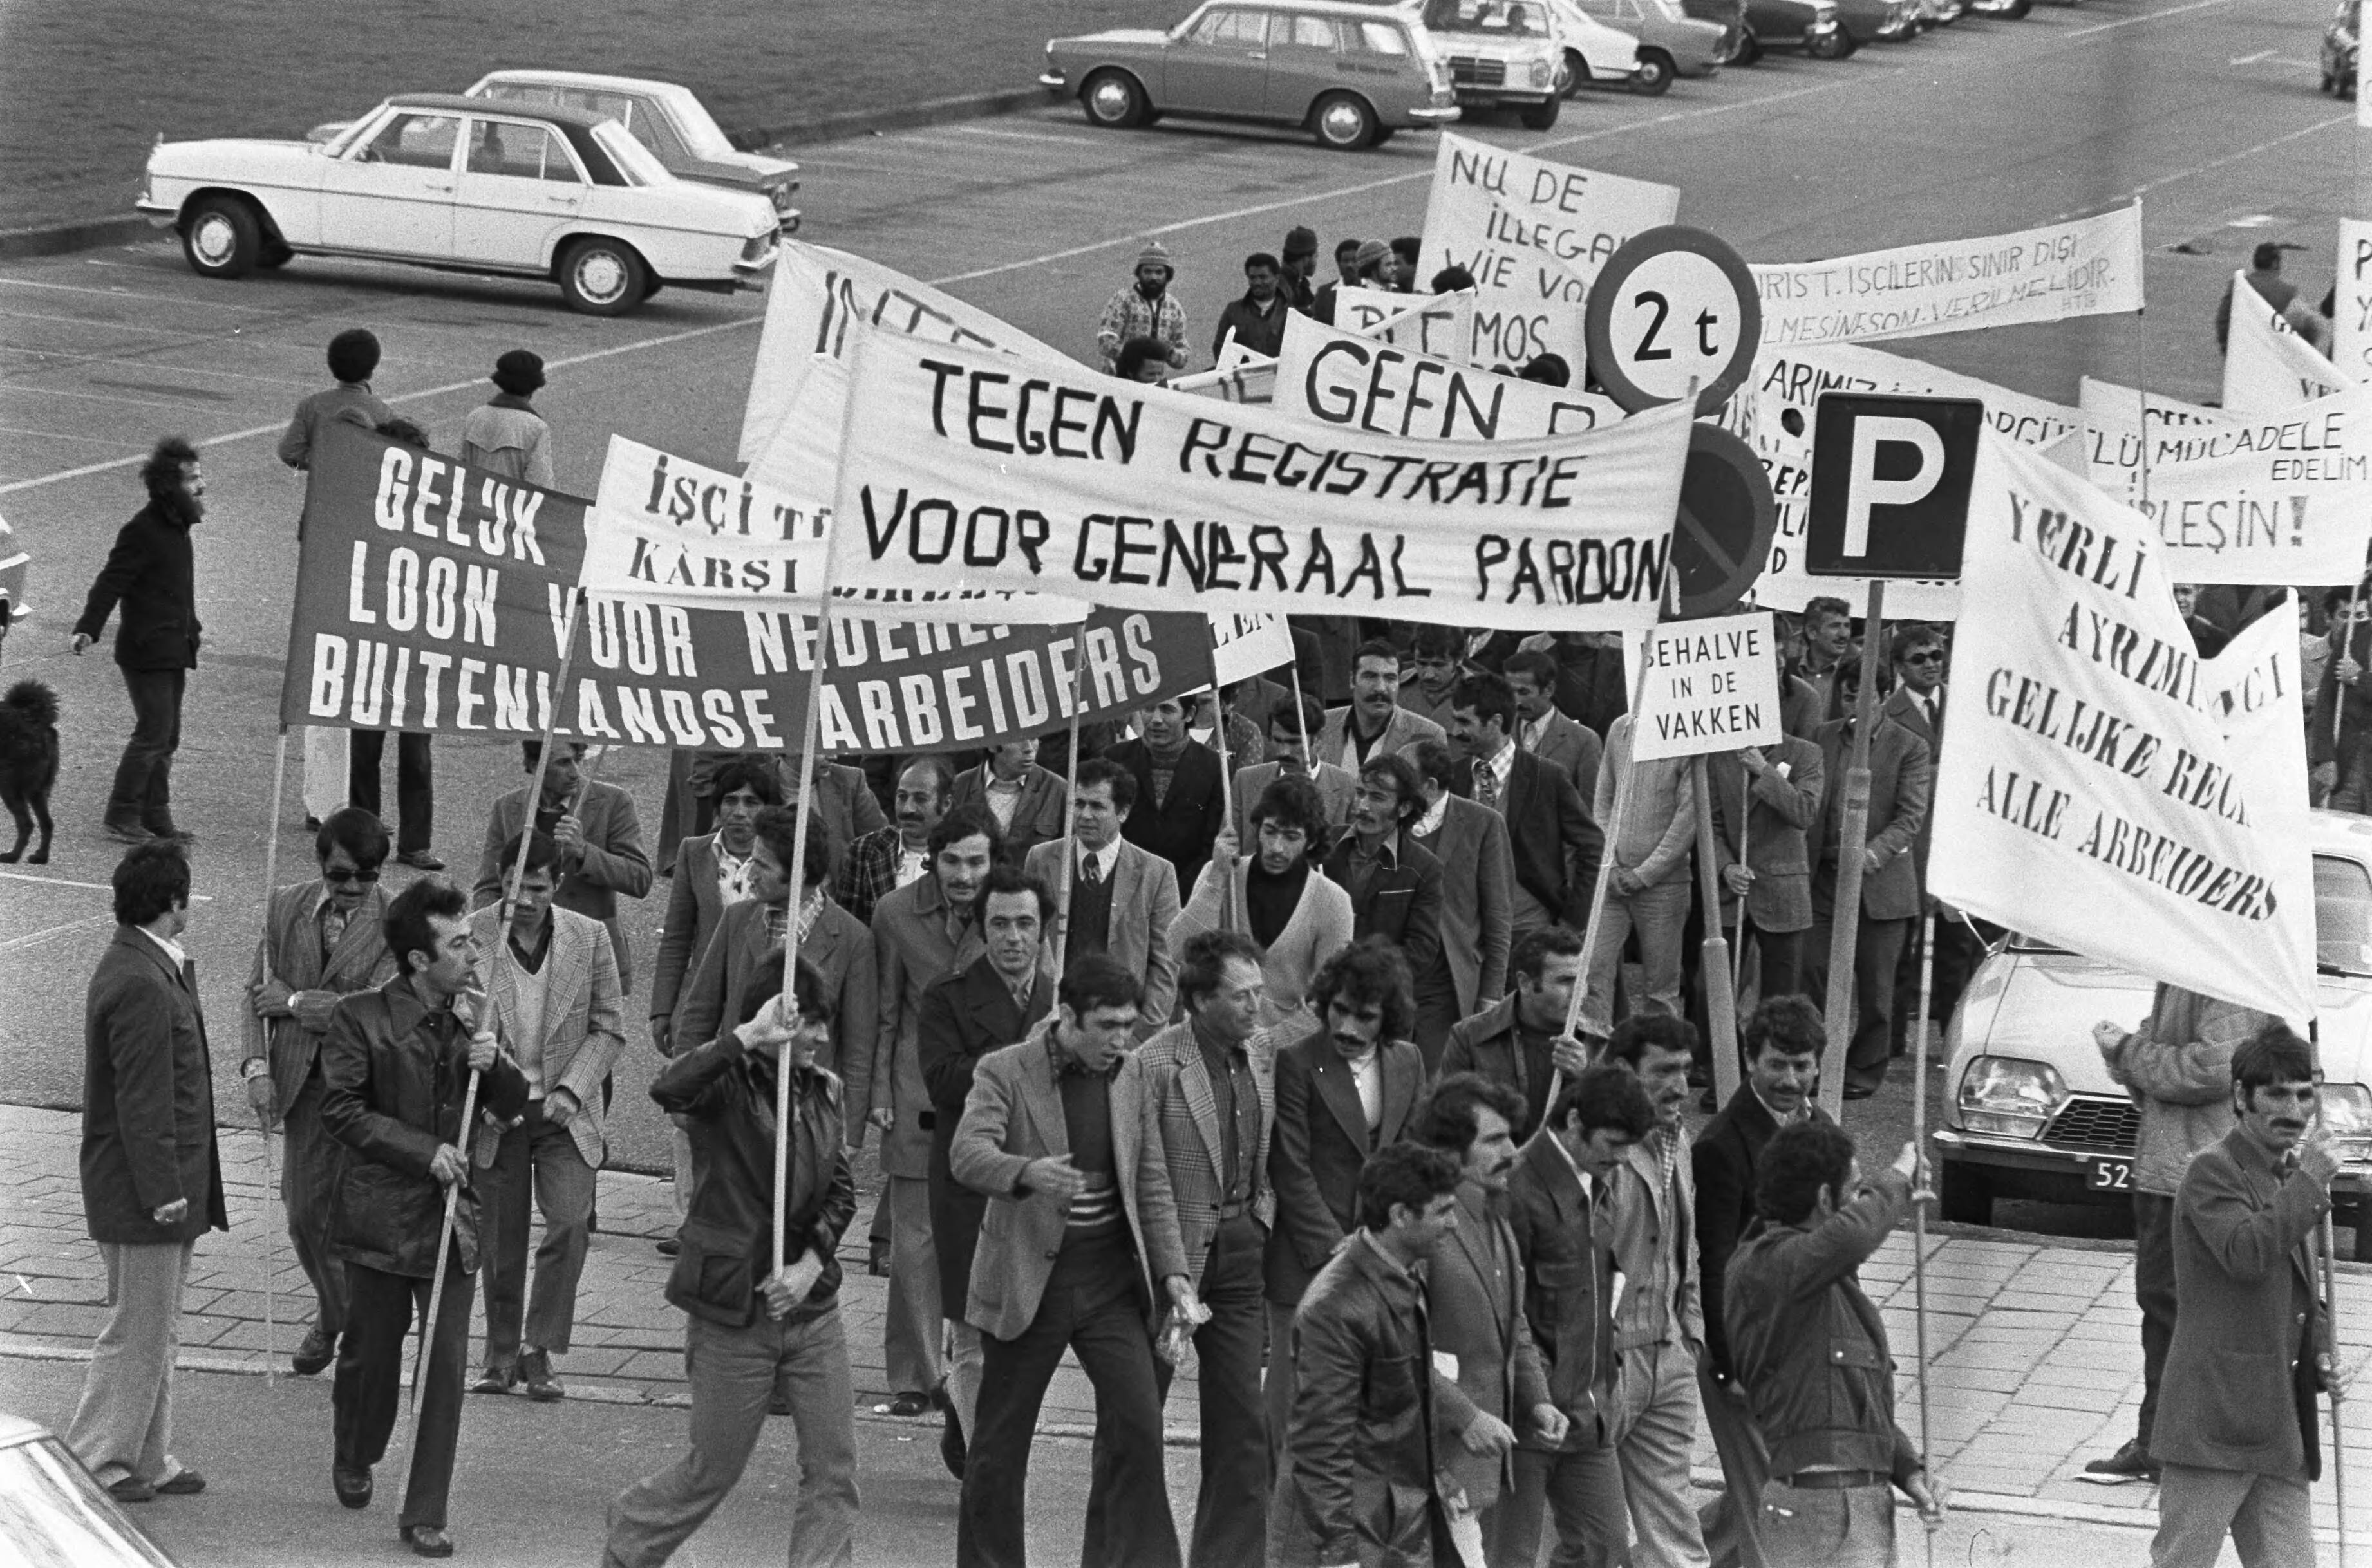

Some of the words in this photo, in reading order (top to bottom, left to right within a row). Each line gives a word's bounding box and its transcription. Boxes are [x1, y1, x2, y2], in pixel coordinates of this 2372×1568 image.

[1451, 149, 1509, 192] NU
[1530, 169, 1588, 214] DE
[1487, 203, 1626, 263] iLLEGA
[1633, 290, 1672, 361] 2
[1695, 307, 1718, 355] t
[919, 358, 1144, 465] TEGEN
[1179, 418, 1589, 509] REGISTRATIE
[1843, 415, 1945, 557] P
[860, 484, 1050, 575] VOOR
[1476, 532, 1672, 606] PARDON
[349, 541, 498, 648] LOON
[548, 583, 699, 678] VOOR
[309, 632, 784, 749] BUITENLANDSE
[819, 613, 1161, 749] ARBEIDERS
[1656, 702, 1761, 740] VAKKEN
[1671, 677, 1693, 700] IN
[1711, 671, 1737, 694] DE
[1987, 667, 2161, 779] GELIJKE
[1977, 764, 2070, 839] ALLE
[2078, 809, 2277, 921] ARBEIDERS
